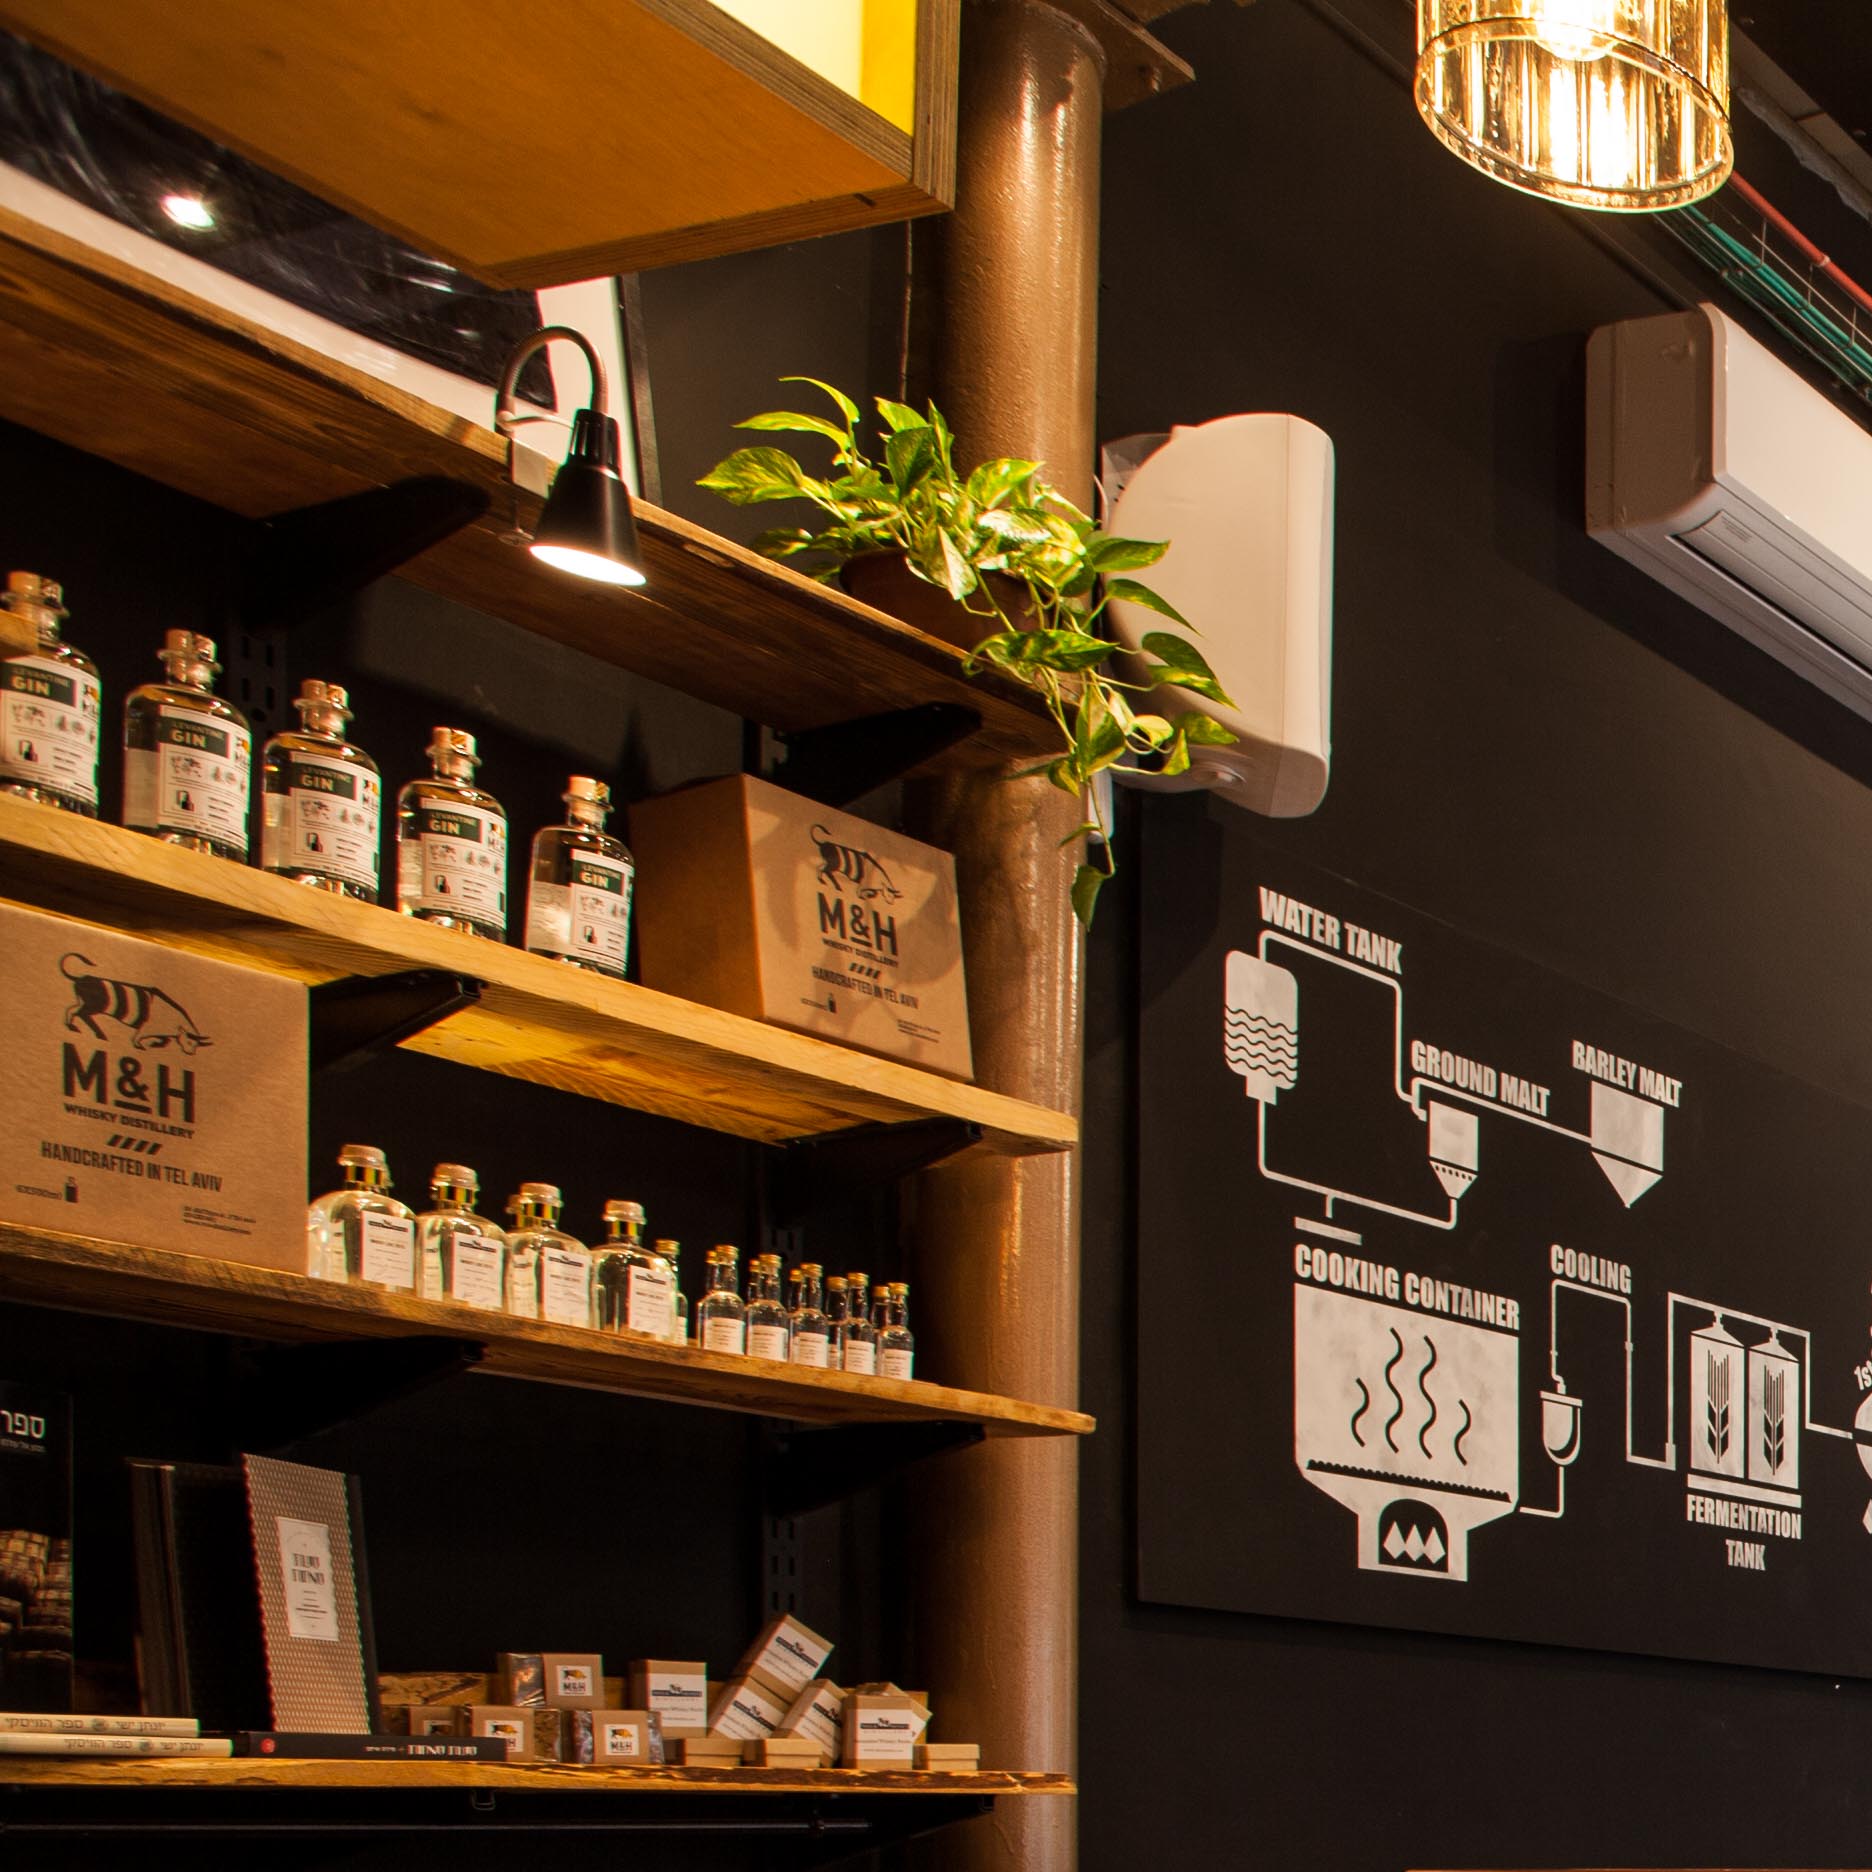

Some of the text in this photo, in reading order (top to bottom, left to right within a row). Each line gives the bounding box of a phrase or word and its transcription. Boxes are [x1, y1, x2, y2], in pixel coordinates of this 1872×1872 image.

[12, 674, 50, 697] GIN
[171, 729, 206, 748] GIN
[301, 774, 334, 792] GIN
[429, 819, 461, 836] GIN
[580, 872, 610, 889] GIN
[816, 891, 898, 956] M&H
[1258, 886, 1402, 976] WATER TANK
[873, 984, 883, 999] IN
[884, 987, 899, 1004] TEL
[62, 1041, 196, 1124] M&H
[1411, 1039, 1550, 1117] GROUND MALT
[1571, 1039, 1682, 1108] BARLEY MALT
[64, 1102, 196, 1140] WHISKY DISTILLERY
[40, 1140, 223, 1193] HANDCRAFTED IN TEL AVIV
[1294, 1243, 1520, 1331] COOKING CONTAINER
[1550, 1243, 1632, 1295] COOLING
[1686, 1493, 1802, 1540] FERMENTATION
[1725, 1539, 1766, 1571] TANK
